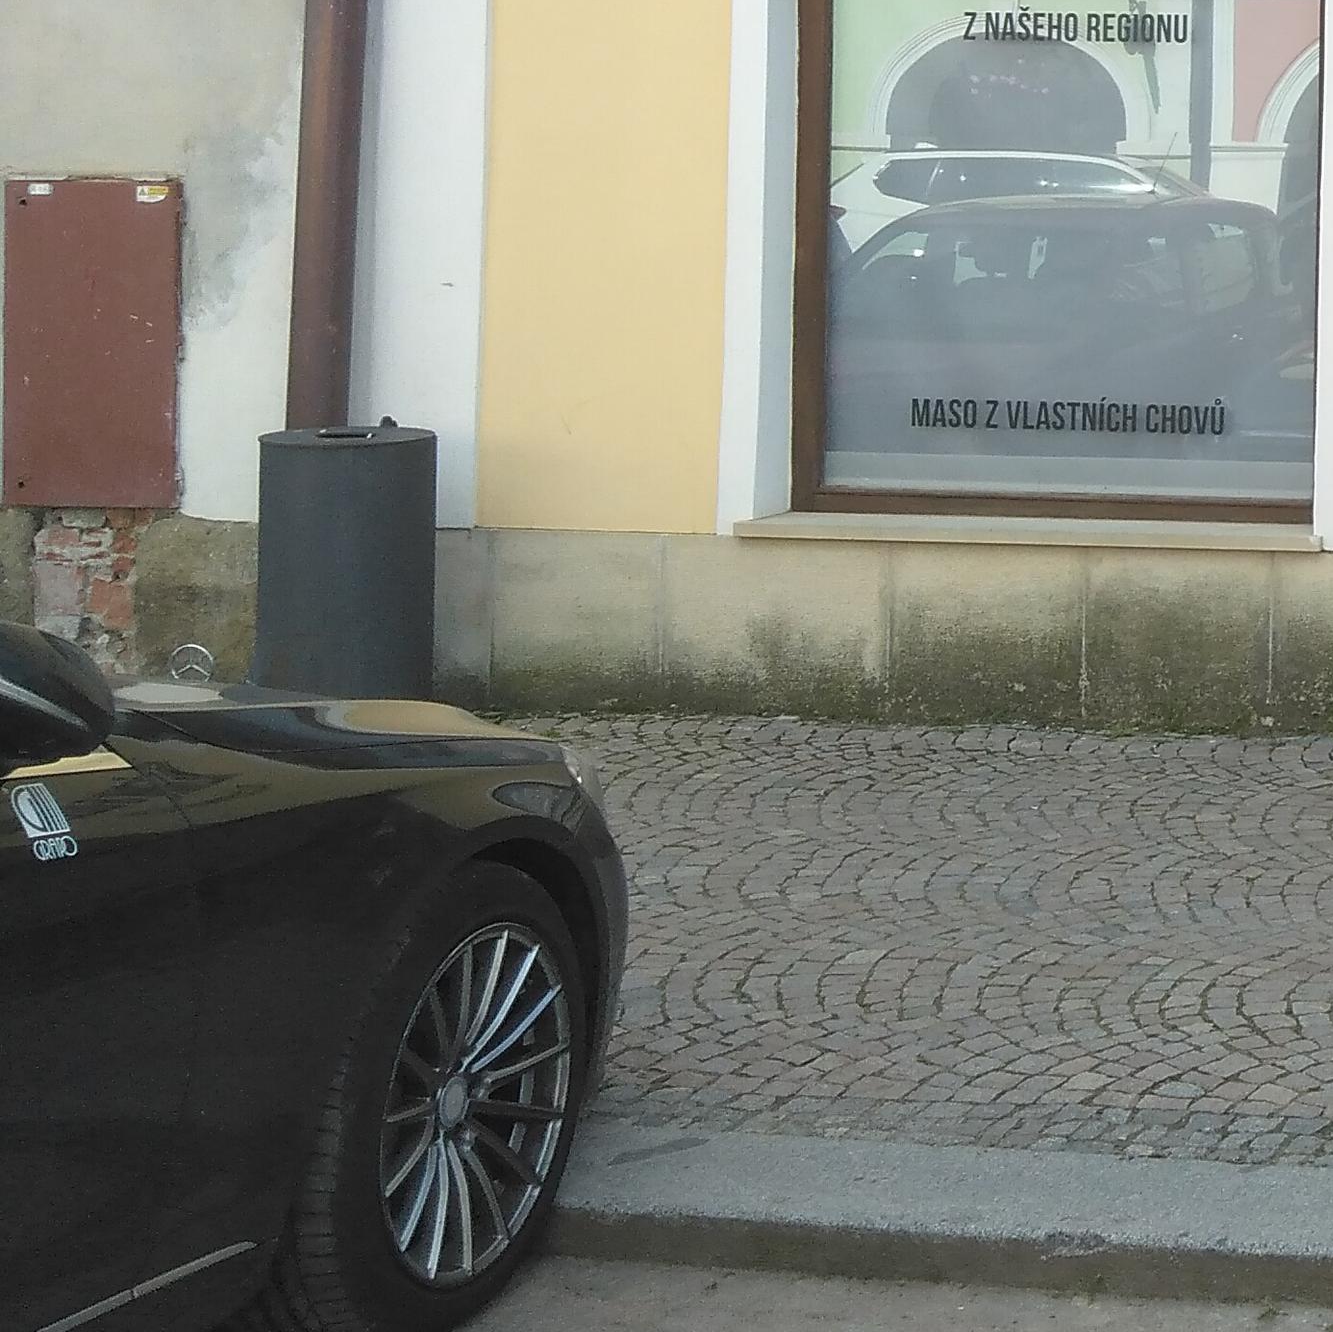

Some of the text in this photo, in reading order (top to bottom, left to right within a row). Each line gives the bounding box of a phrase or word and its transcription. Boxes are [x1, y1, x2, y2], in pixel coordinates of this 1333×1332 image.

[963, 6, 1188, 43] Z NAŠEHO REGIONU
[911, 397, 1226, 436] MASO Z VLASTNÍCH CHOVŮ
